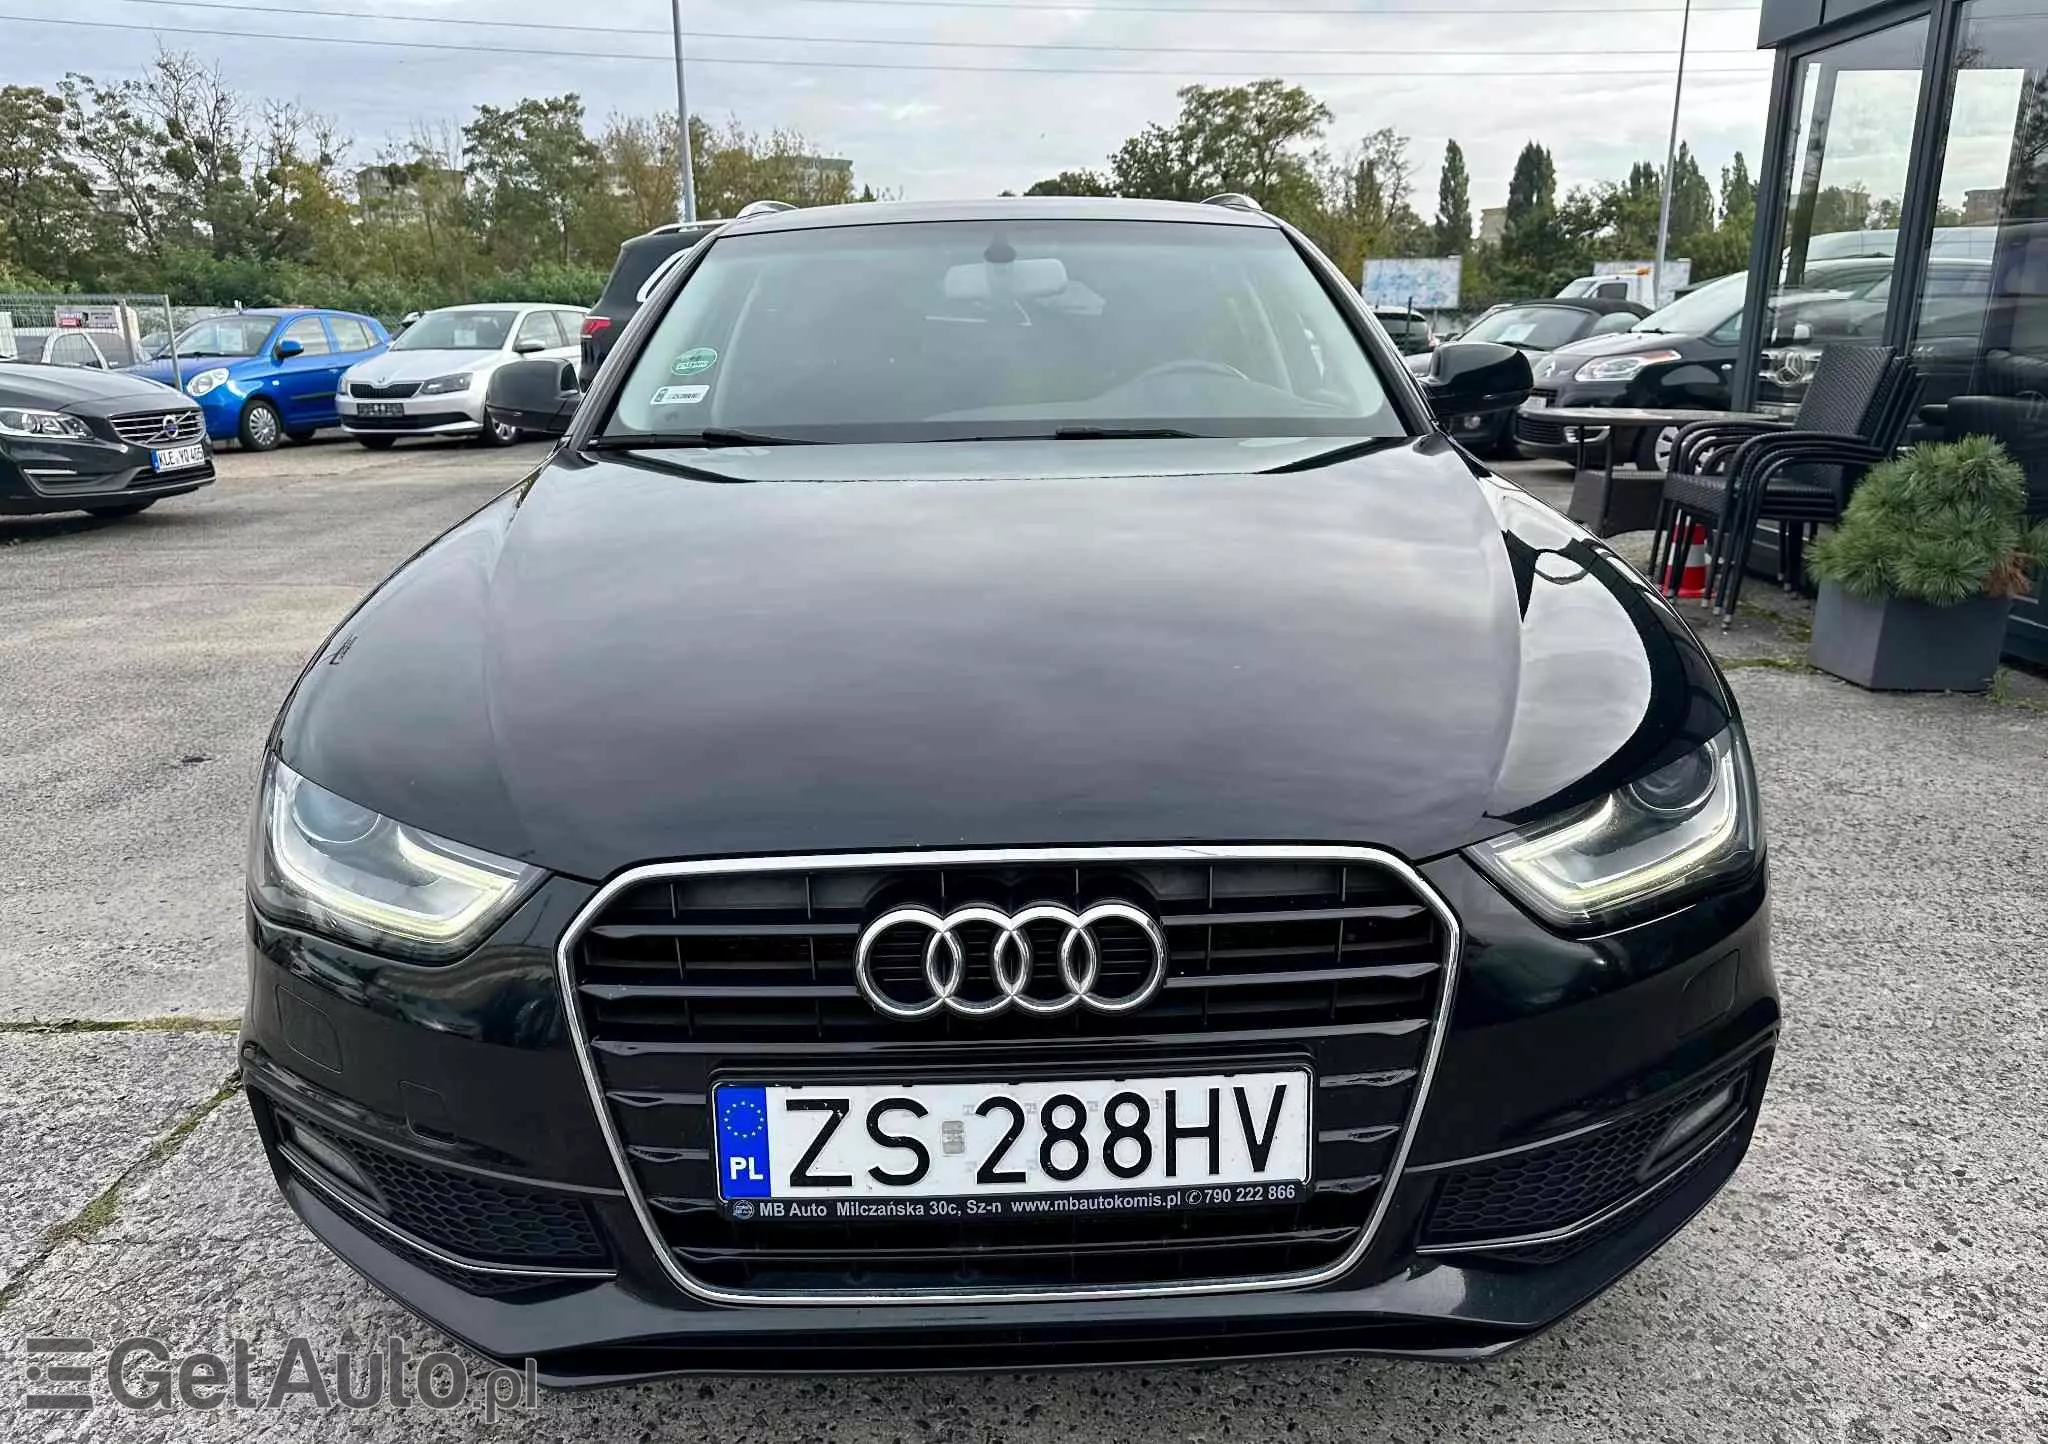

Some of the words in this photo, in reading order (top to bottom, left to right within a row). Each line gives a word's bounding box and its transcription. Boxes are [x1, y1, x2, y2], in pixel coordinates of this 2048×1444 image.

[785, 1097, 931, 1188] ZS
[974, 1084, 1287, 1185] 288HV
[730, 1157, 764, 1181] PL
[759, 1202, 785, 1217] MB
[789, 1202, 828, 1217] Auto
[836, 1200, 924, 1217] Milczańska
[929, 1200, 962, 1216] 30c,
[967, 1199, 1002, 1214] Sz-n
[1010, 1190, 1182, 1213] www.mbautokomis.pl
[1204, 1188, 1231, 1204] 790
[1236, 1186, 1263, 1202] 222
[1268, 1184, 1295, 1200] 866
